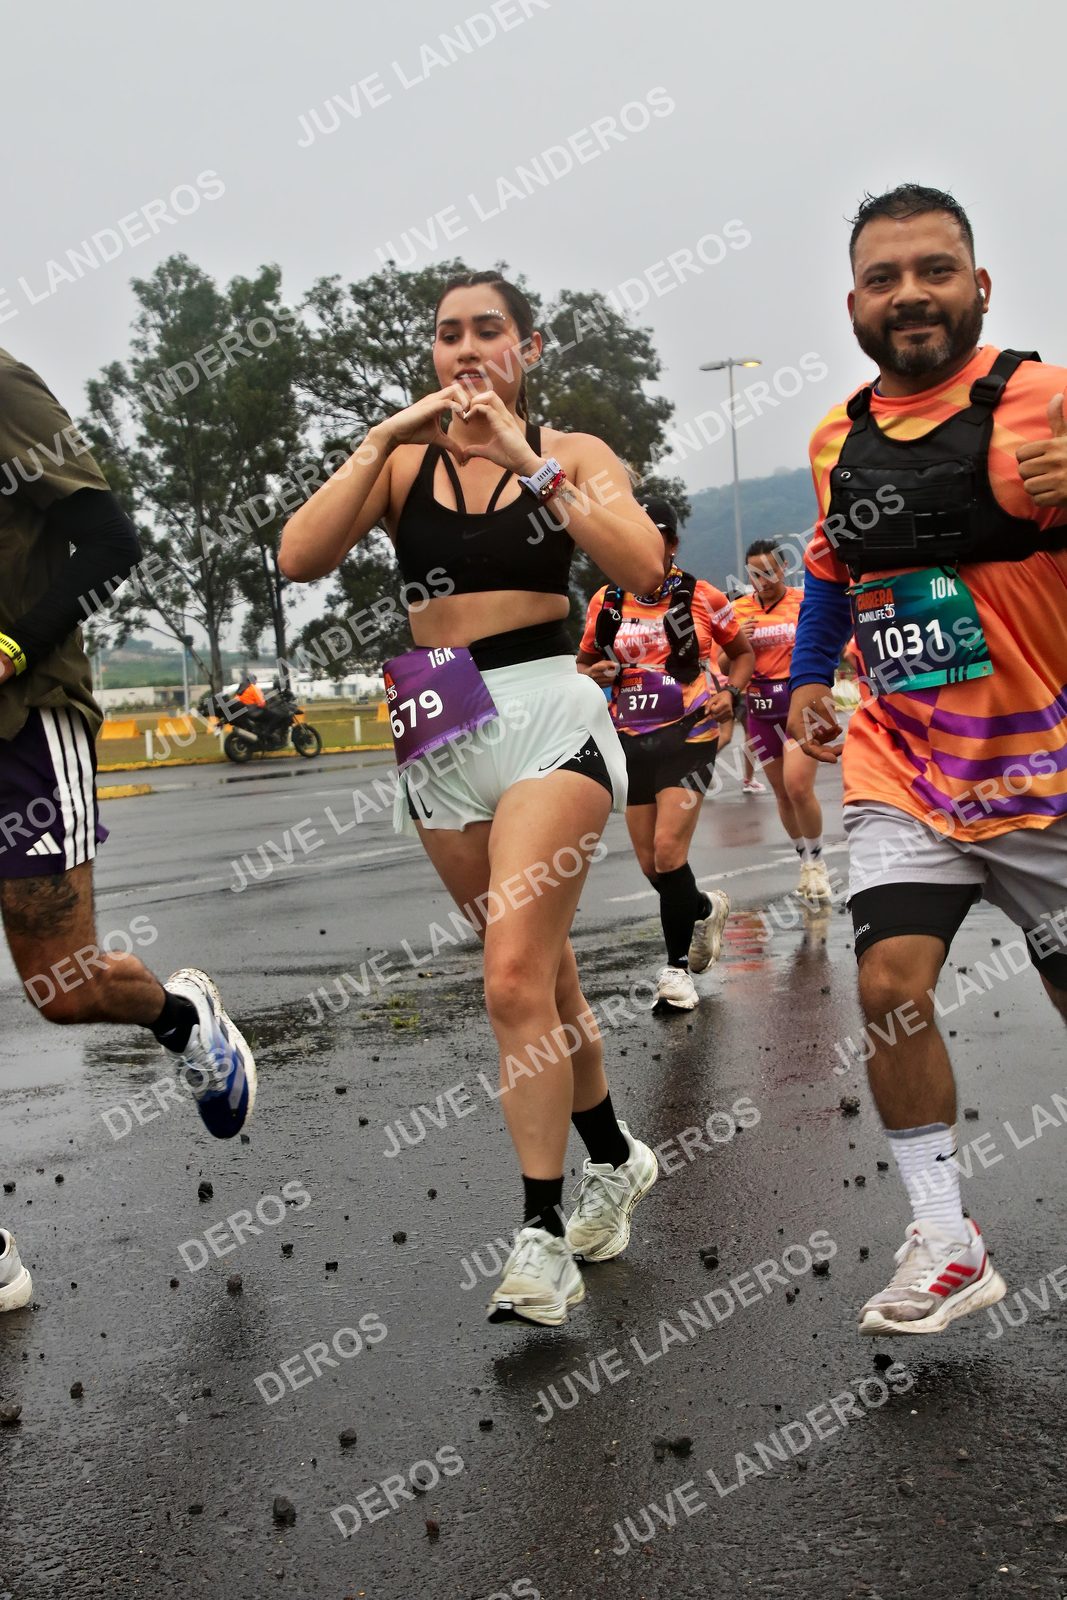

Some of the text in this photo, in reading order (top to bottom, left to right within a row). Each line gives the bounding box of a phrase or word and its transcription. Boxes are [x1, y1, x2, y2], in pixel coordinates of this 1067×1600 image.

[930, 576, 958, 599] 10K
[750, 623, 796, 640] ARRERA
[872, 619, 944, 660] 1031
[428, 648, 456, 669] 15K
[629, 694, 659, 711] 377
[754, 699, 773, 710] 737
[390, 690, 444, 738] 679
